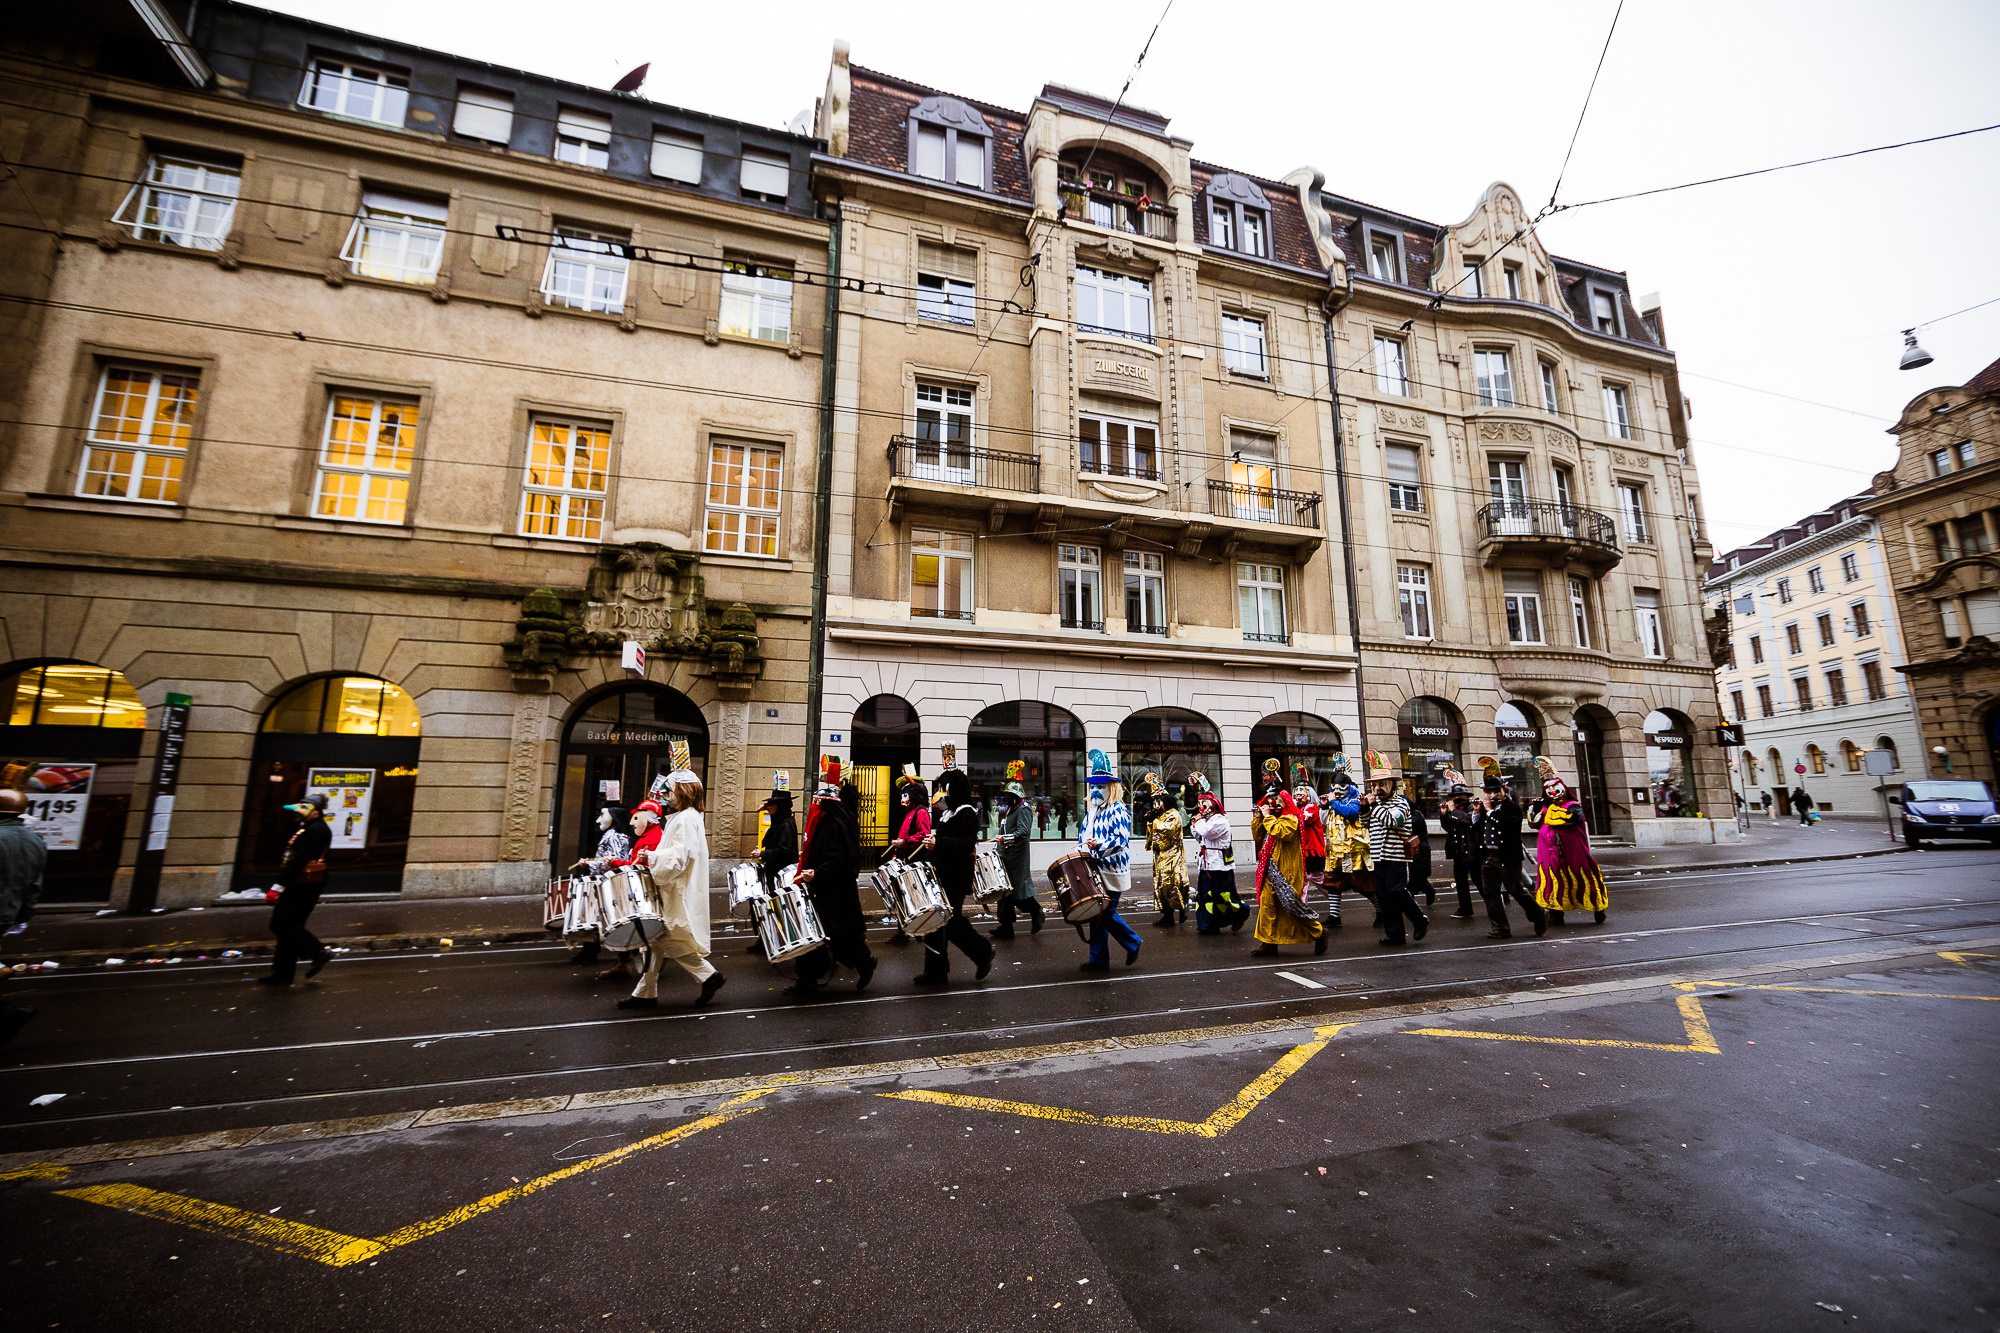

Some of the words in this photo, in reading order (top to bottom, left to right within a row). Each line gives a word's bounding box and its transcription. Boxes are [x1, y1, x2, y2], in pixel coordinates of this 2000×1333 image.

[587, 730, 621, 740] Basler
[625, 731, 689, 742] Medienhaus
[1411, 726, 1449, 736] NESPRESSO
[1501, 728, 1536, 739] NESPRESSO
[1653, 734, 1683, 744] NESPRESSO
[1150, 743, 1161, 751] Das
